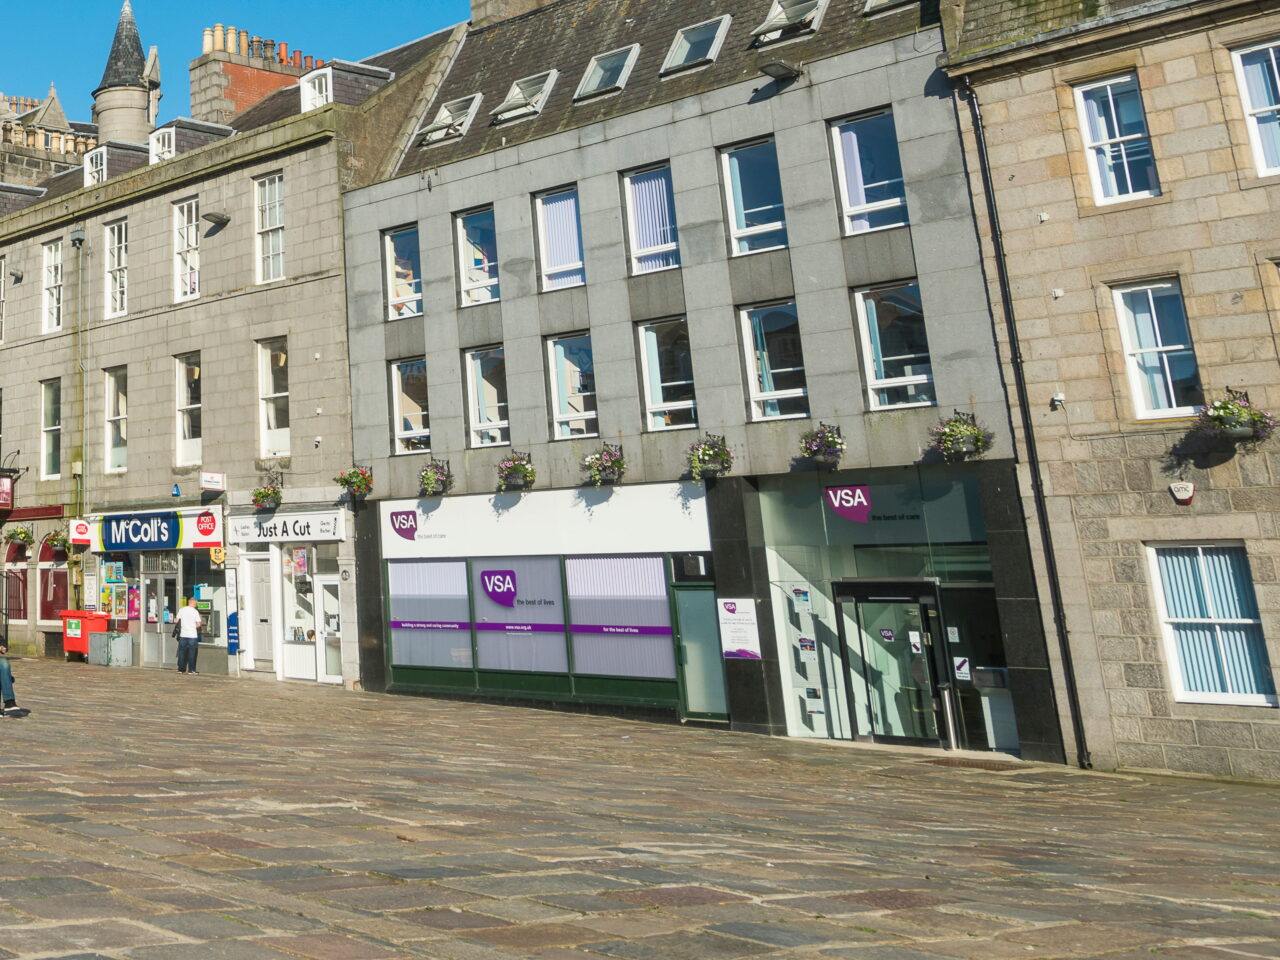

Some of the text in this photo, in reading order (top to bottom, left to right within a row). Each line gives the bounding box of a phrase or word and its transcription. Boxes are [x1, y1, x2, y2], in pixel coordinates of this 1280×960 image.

[828, 488, 868, 507] VSA
[198, 522, 215, 530] OFFICE
[200, 515, 212, 523] POST
[392, 514, 416, 529] VSA
[111, 517, 169, 544] McColl's
[257, 520, 311, 538] Just A Cut
[484, 574, 515, 592] VSA
